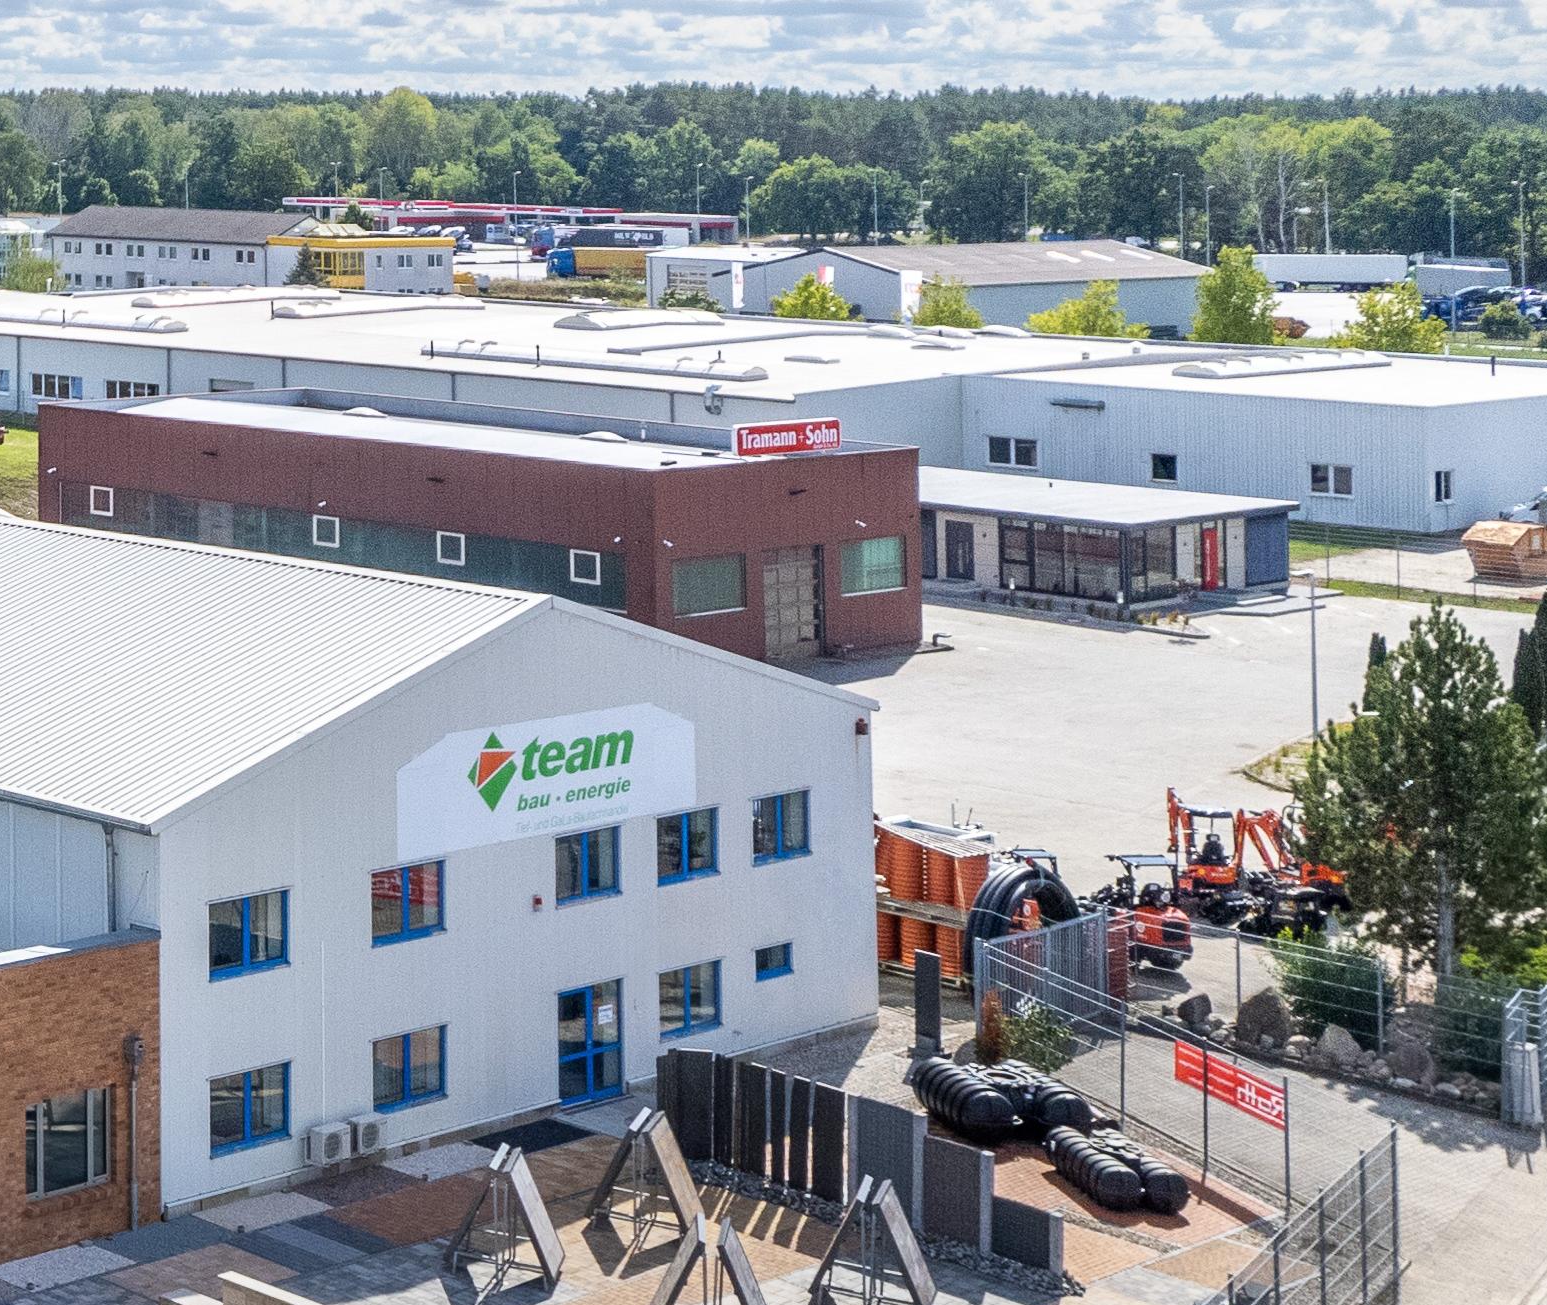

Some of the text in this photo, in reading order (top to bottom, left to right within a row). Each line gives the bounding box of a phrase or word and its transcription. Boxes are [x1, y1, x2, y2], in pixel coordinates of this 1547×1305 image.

[739, 429, 796, 449] Tramann
[805, 424, 838, 446] Sohn
[521, 729, 634, 781] team
[517, 777, 631, 812] bau energie
